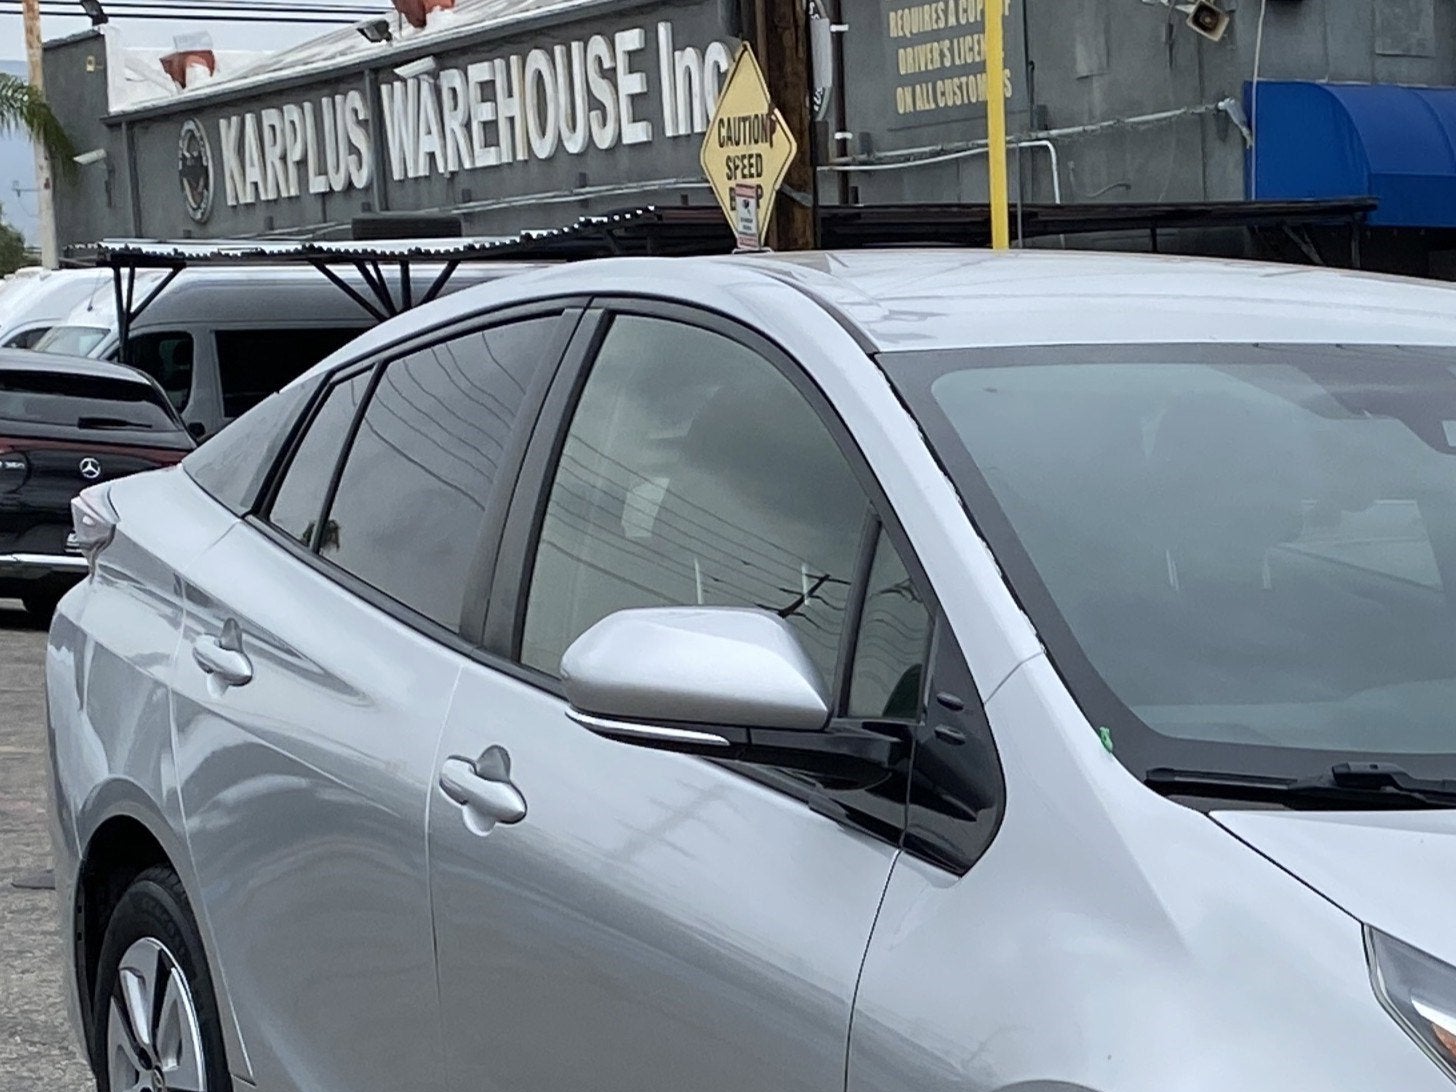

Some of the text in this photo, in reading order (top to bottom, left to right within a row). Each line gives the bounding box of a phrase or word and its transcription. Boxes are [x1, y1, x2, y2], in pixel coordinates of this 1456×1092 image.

[889, 1, 945, 38] REQUIRES
[948, 0, 957, 27] A
[959, 0, 984, 26] COP
[897, 33, 1003, 75] DRIVER'S LICEN
[896, 69, 1013, 115] ON ALL CUSTOMS
[219, 90, 372, 206] KARPLUS
[381, 28, 652, 181] WAREHOUSE
[657, 21, 730, 138] Inc
[717, 113, 769, 148] CAUTION
[725, 152, 763, 181] SPEED
[729, 184, 764, 211] BP
